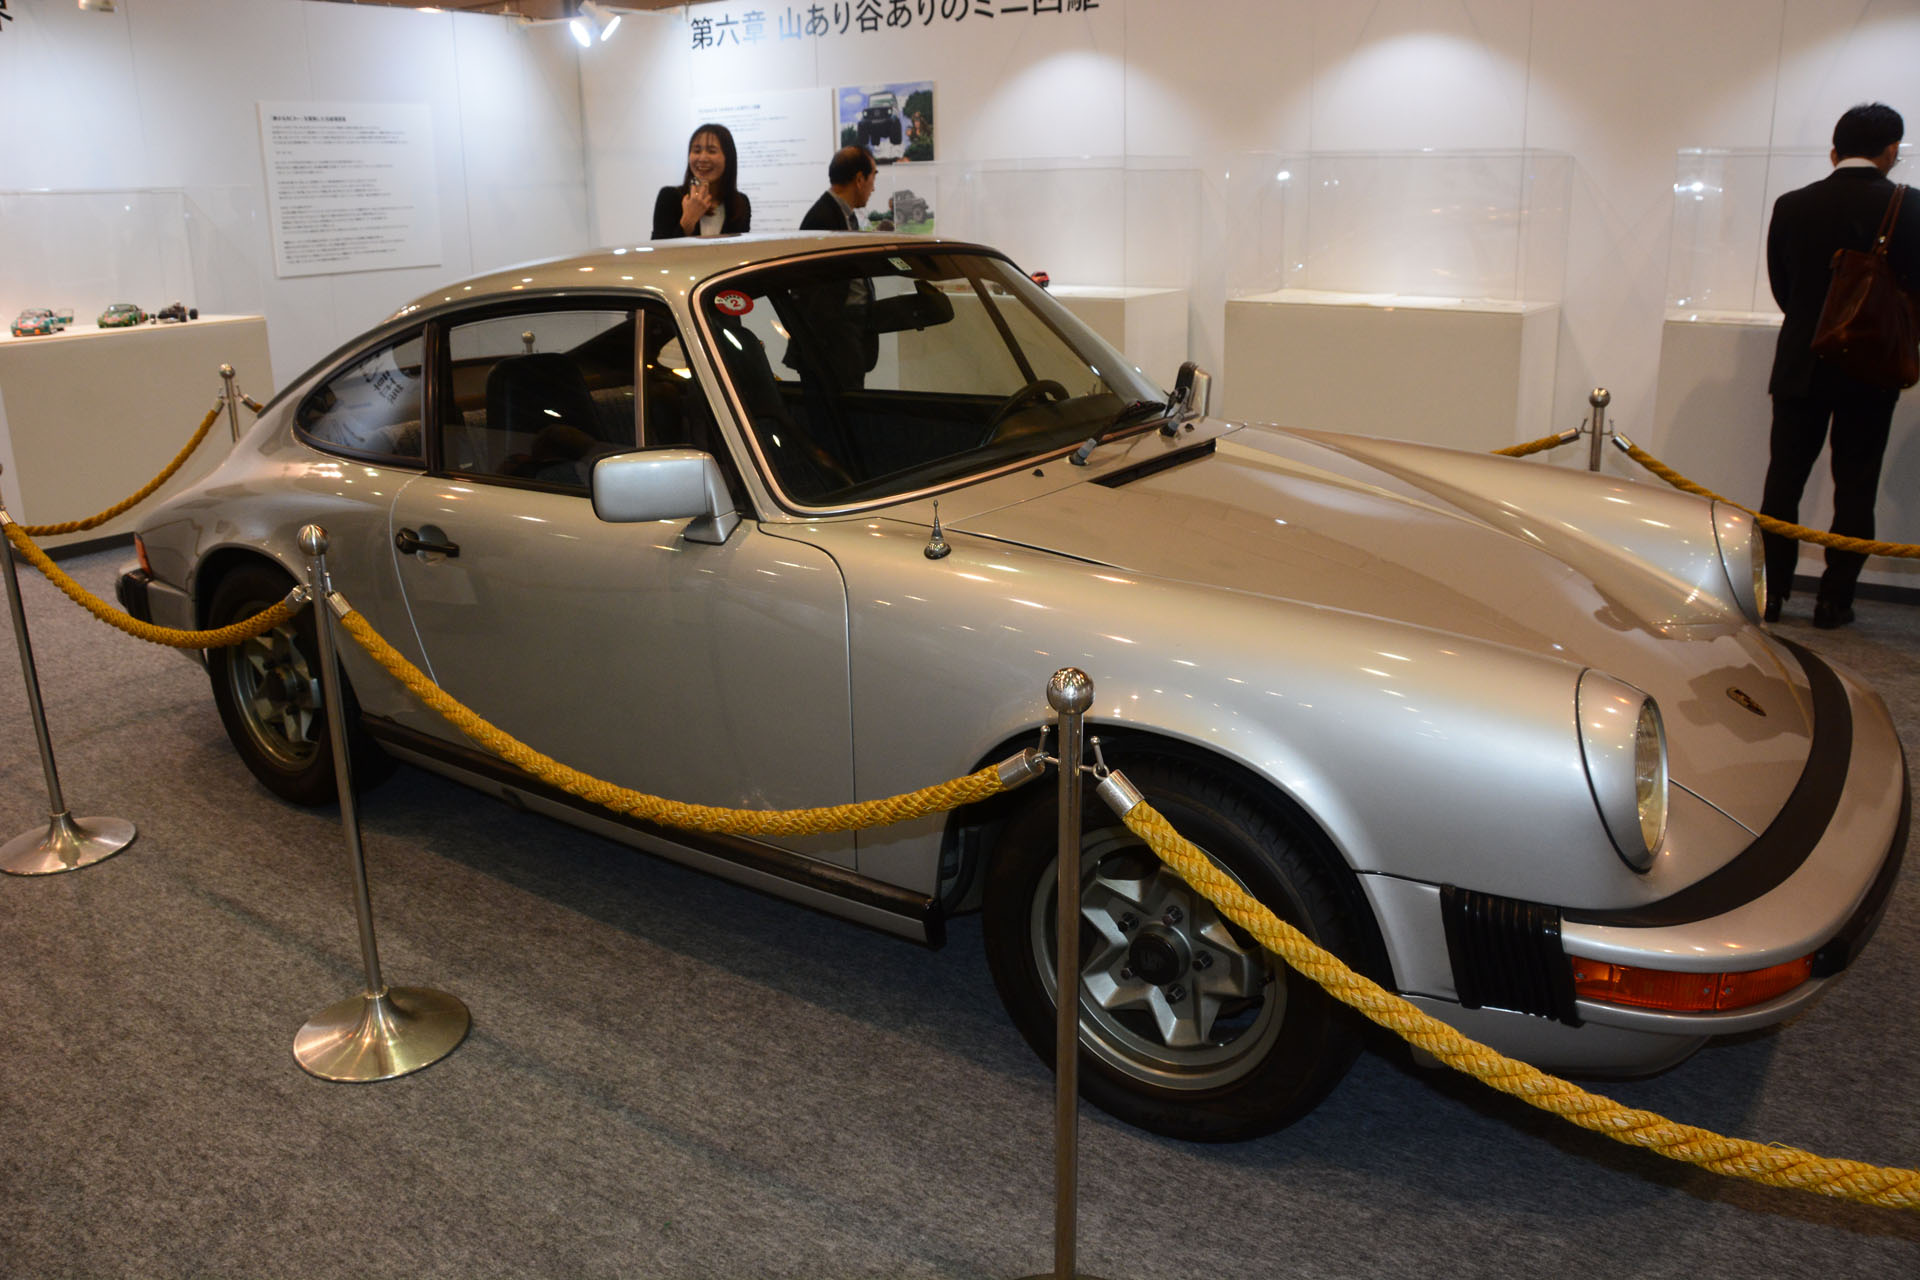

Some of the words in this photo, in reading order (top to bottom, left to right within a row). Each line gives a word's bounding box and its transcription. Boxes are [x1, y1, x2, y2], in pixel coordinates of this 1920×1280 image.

[691, 10, 766, 50] 第六章
[731, 299, 741, 308] 2
